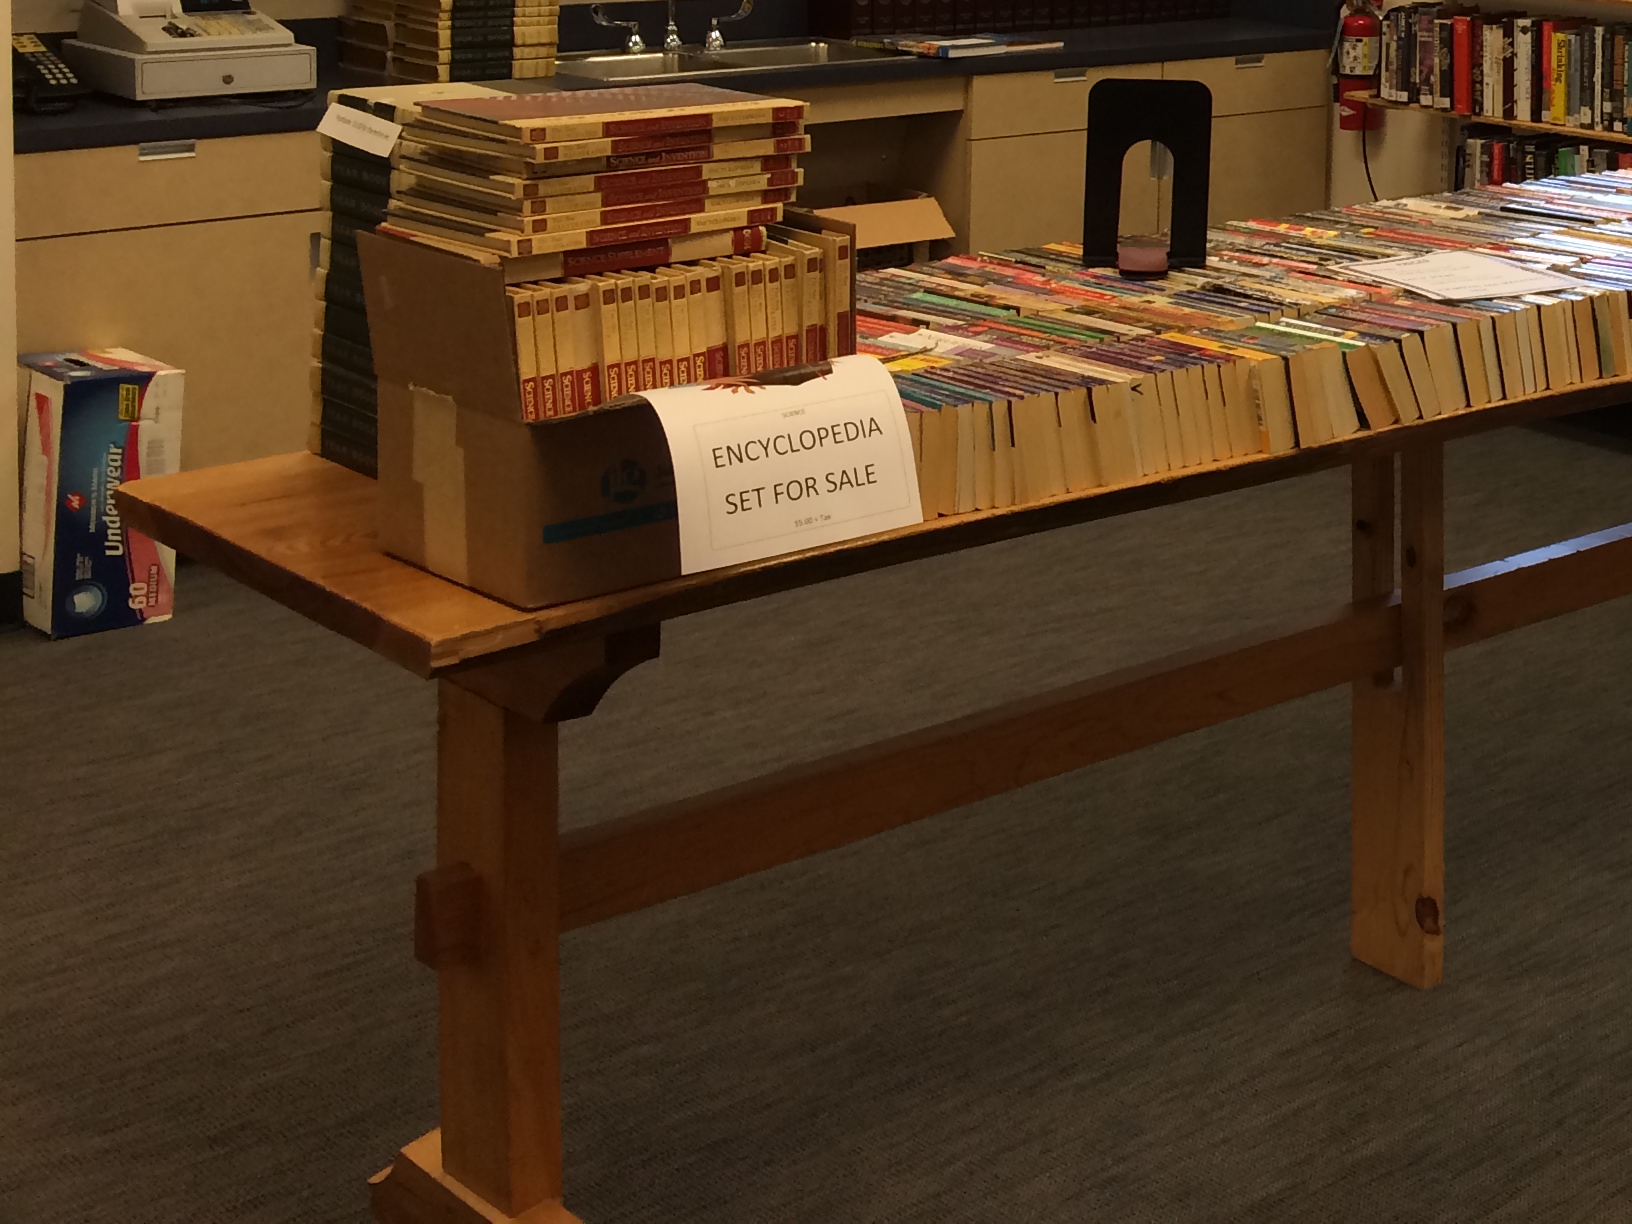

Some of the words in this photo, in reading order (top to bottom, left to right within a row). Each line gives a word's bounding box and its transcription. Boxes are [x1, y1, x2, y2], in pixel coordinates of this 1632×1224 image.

[1554, 39, 1566, 84] Shrinking
[610, 154, 647, 167] SCIENCE
[661, 149, 708, 161] INVENTION
[568, 253, 606, 267] SCIENCE
[607, 246, 665, 263] SUPPLEMENT
[739, 347, 749, 374] SCIEN
[755, 345, 765, 370] SCIEN
[773, 342, 781, 368] SCIEN
[582, 372, 593, 409] SCIENC
[609, 367, 619, 401] SCIENC
[626, 364, 636, 394] SCIEN
[643, 362, 654, 390] SCIEN
[543, 378, 554, 418] SCIENCE
[562, 375, 573, 413] SCIENCE
[781, 408, 807, 420] SCIENCE
[712, 417, 884, 468] ENCYCLOPEDIA
[104, 444, 123, 557] Underwear
[725, 486, 766, 516] SET
[773, 474, 821, 505] FOR
[825, 463, 879, 494] SALE
[129, 583, 147, 609] 60
[148, 565, 158, 609] MEDIUM
